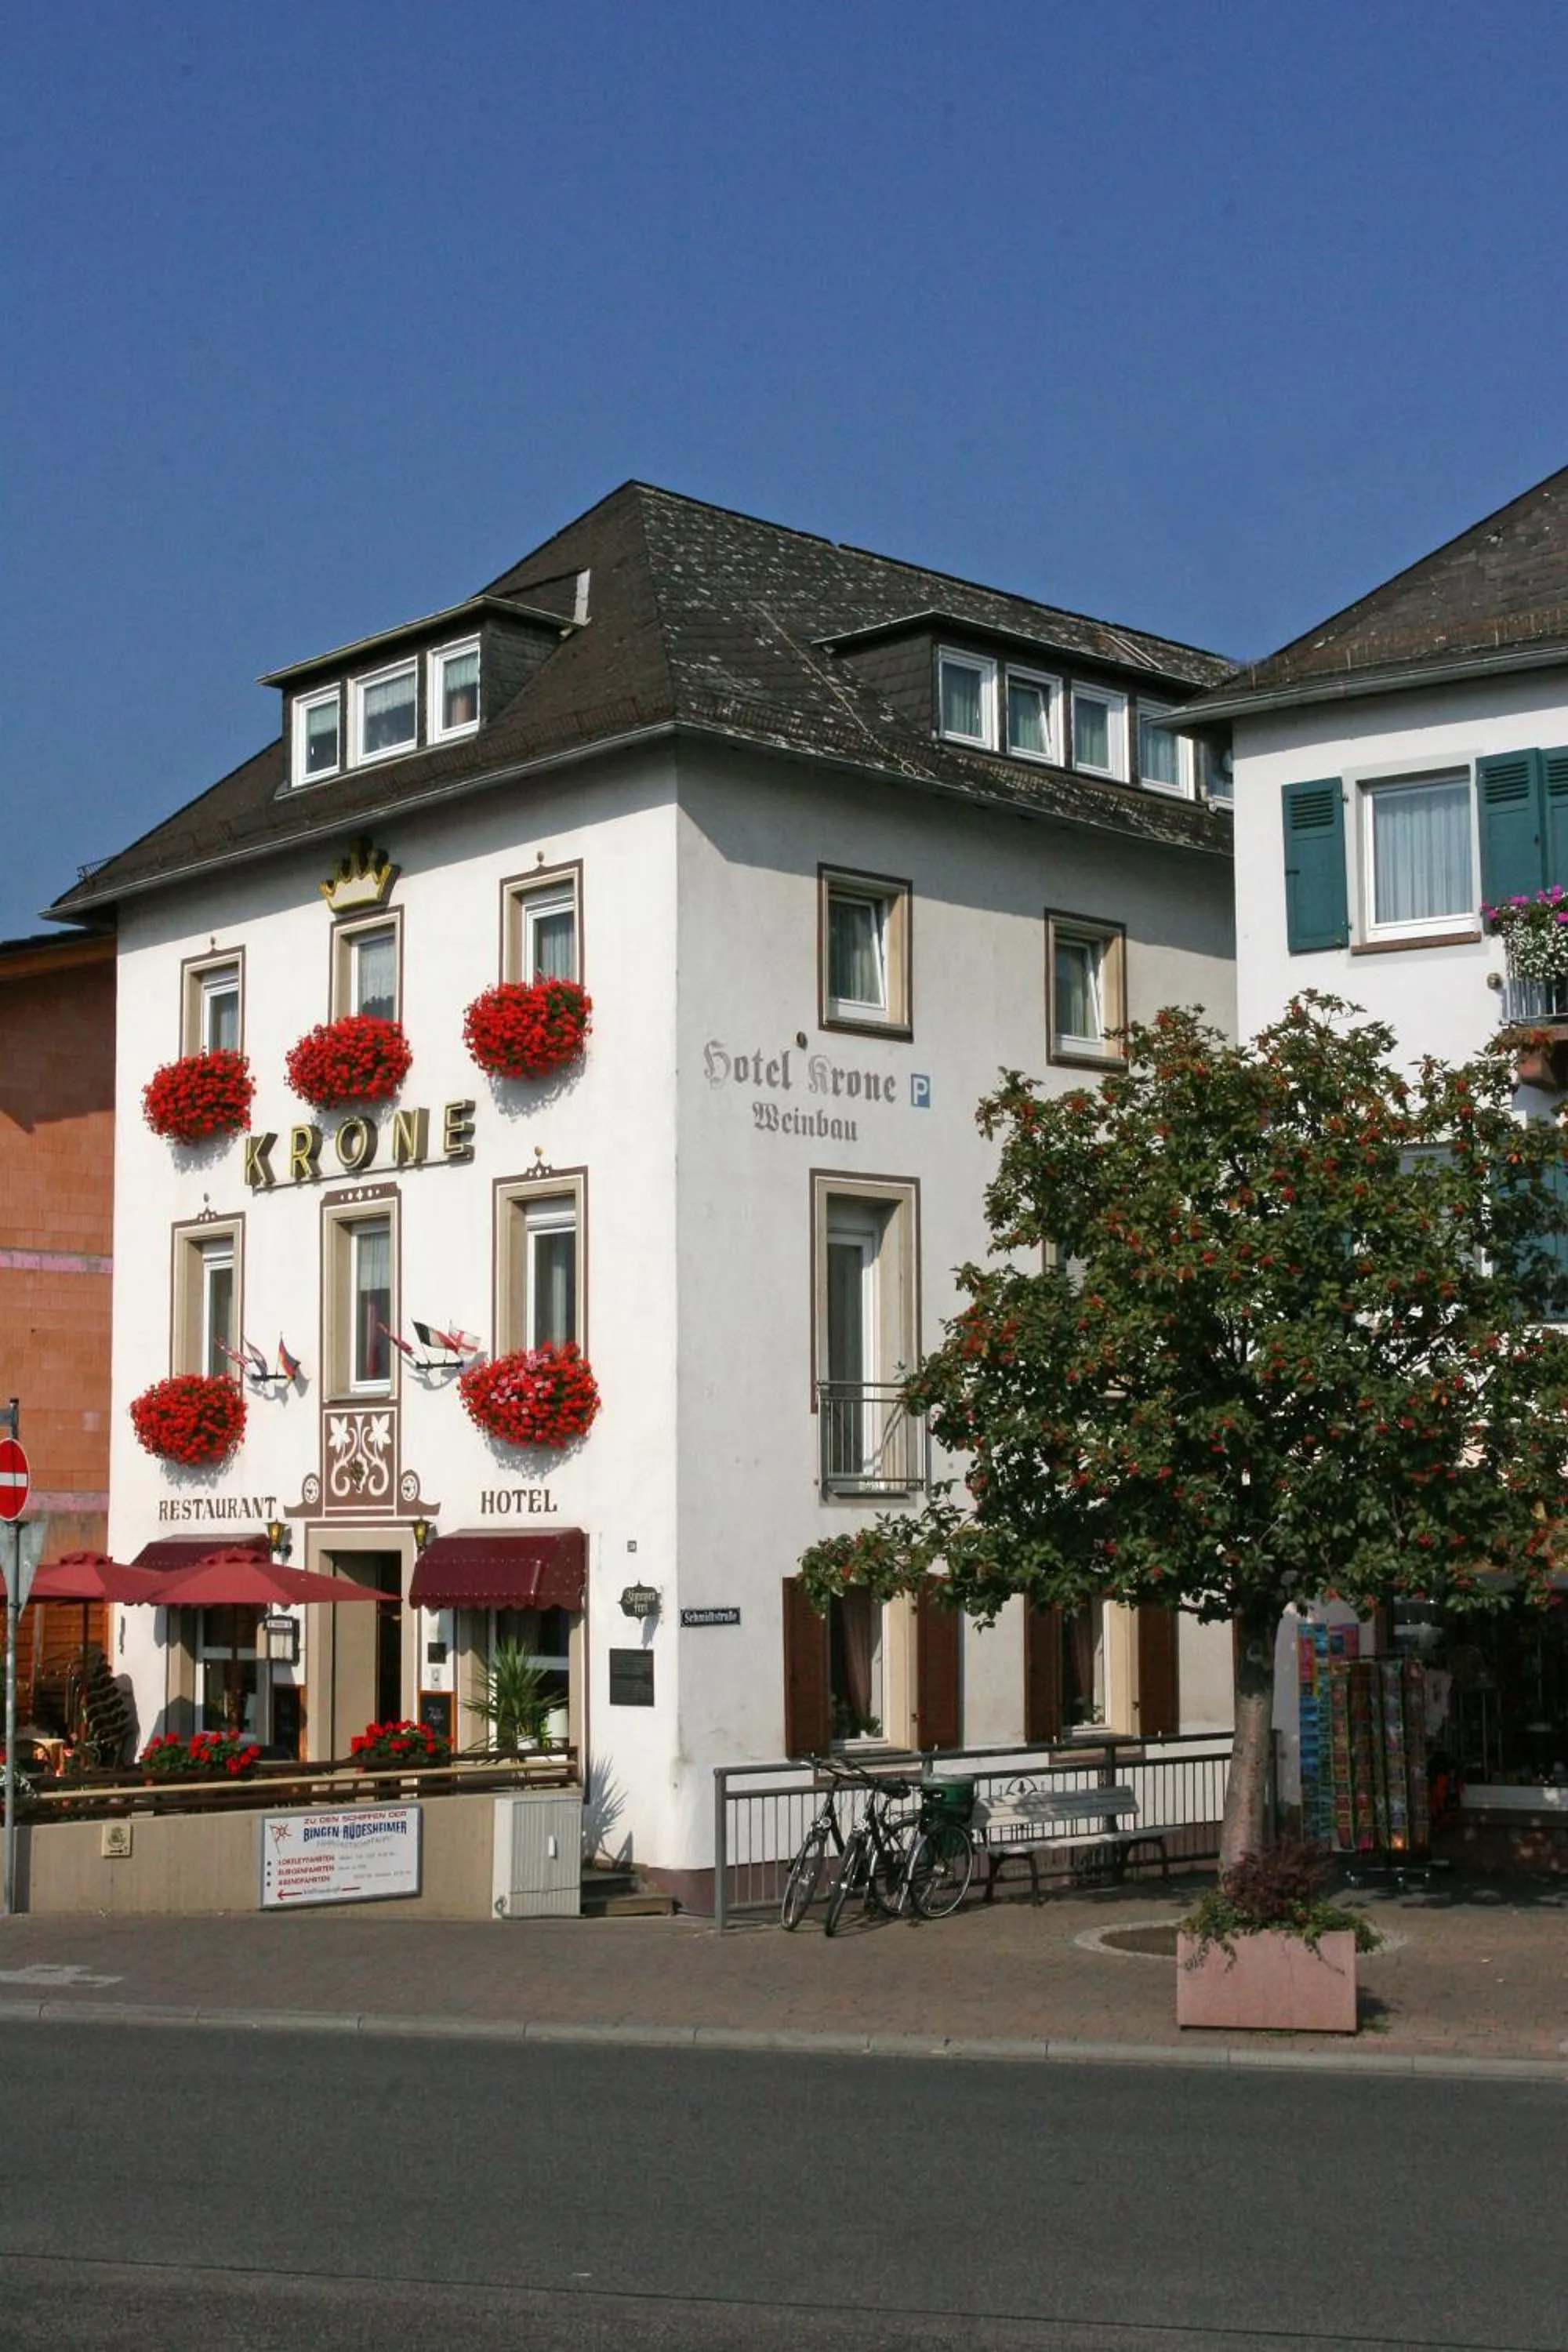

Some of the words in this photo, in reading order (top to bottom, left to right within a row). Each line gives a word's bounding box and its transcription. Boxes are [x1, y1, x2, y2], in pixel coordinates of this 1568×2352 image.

[703, 1040, 793, 1091] Hotel
[808, 1054, 897, 1104] Krone
[913, 1077, 928, 1105] P
[753, 1102, 858, 1142] Weinbau
[245, 1099, 476, 1186] KRONE
[159, 1497, 277, 1521] RESTAURANT
[481, 1489, 557, 1514] HOTEL
[319, 1816, 339, 1824] DEN
[388, 1810, 407, 1819] DER
